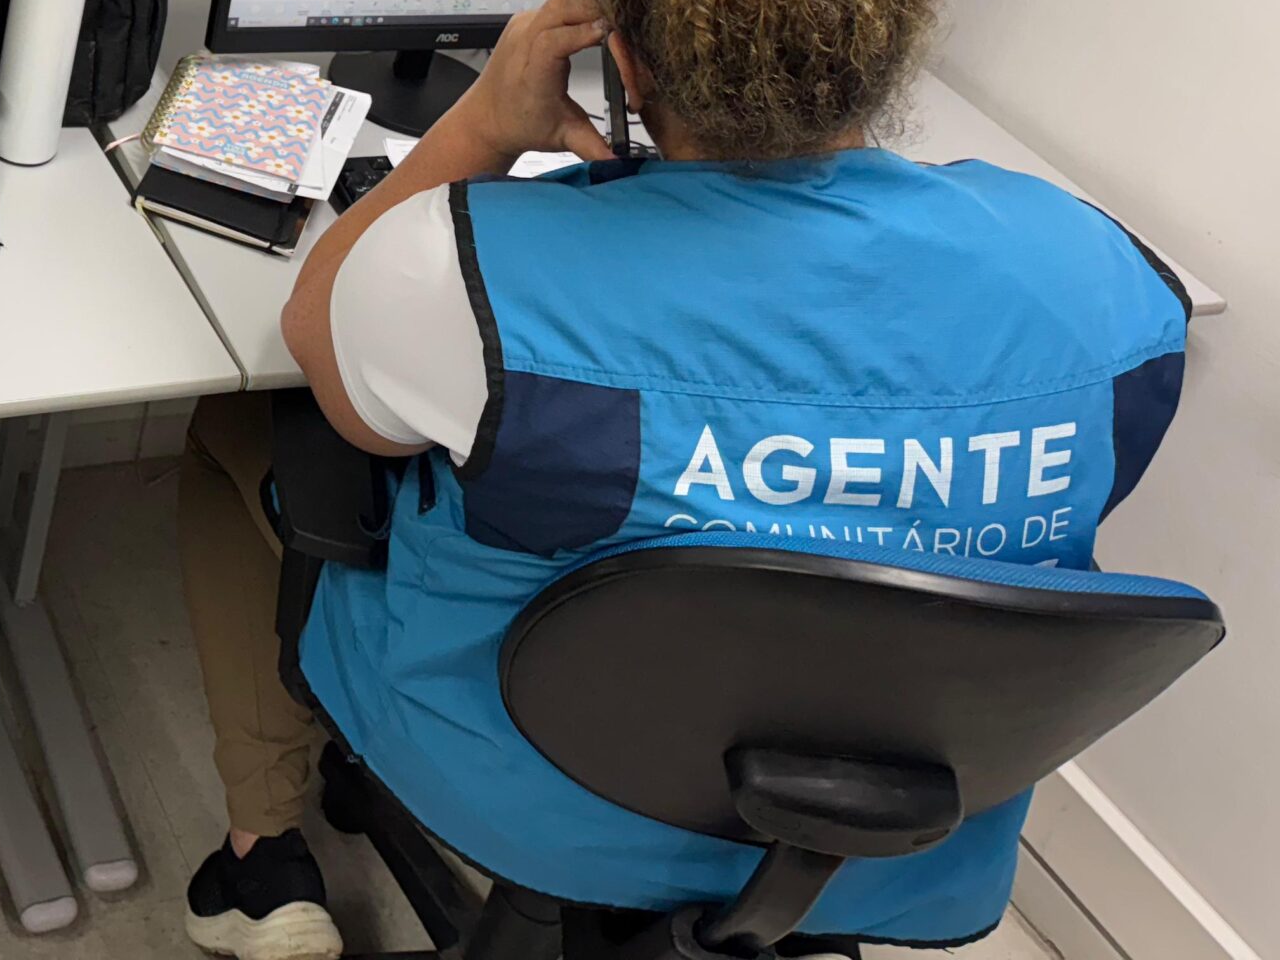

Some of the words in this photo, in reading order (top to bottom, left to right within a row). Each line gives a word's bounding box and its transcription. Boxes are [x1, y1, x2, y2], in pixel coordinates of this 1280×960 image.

[435, 33, 460, 42] AOC
[673, 421, 1077, 509] AGENTE
[1021, 506, 1072, 548] DE
